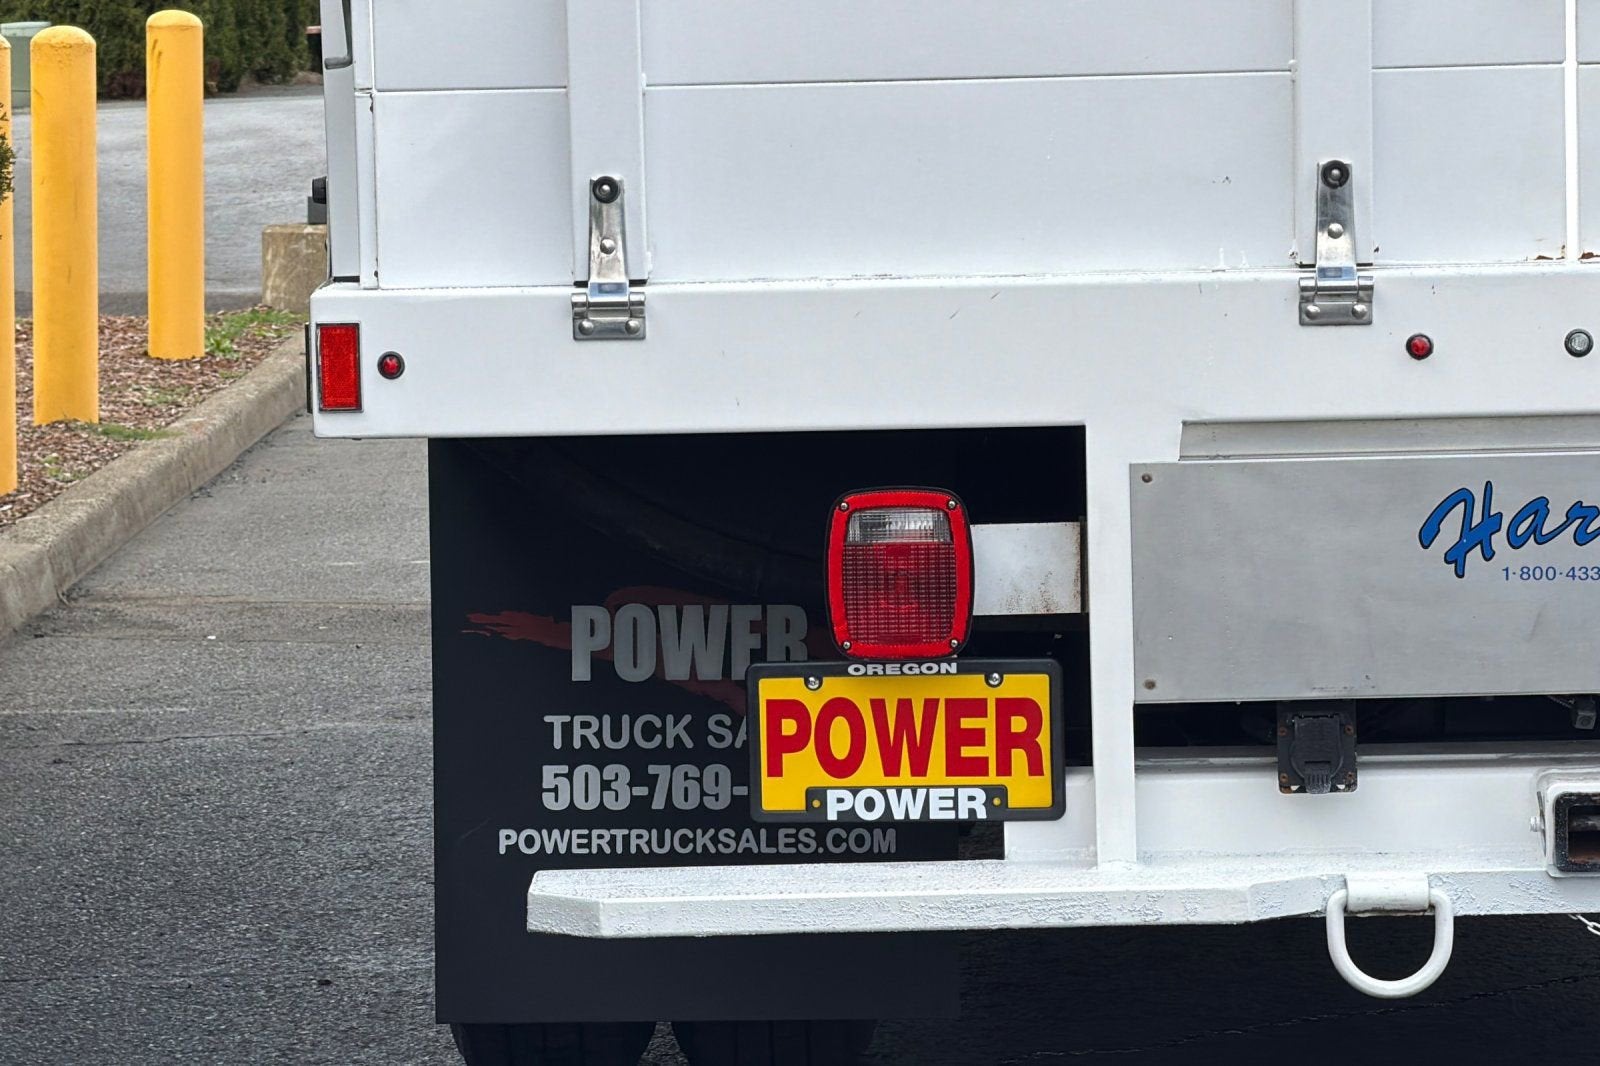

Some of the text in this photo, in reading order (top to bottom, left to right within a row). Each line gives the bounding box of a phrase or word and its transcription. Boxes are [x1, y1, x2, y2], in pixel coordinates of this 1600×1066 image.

[1418, 480, 1600, 579] Har
[571, 603, 808, 682] POWER
[847, 662, 958, 676] OREGON
[543, 714, 694, 750] TRUCK
[765, 696, 1045, 780] POWER
[826, 788, 988, 821] POWER
[498, 828, 897, 855] POWERTRUCKSALES.COM
